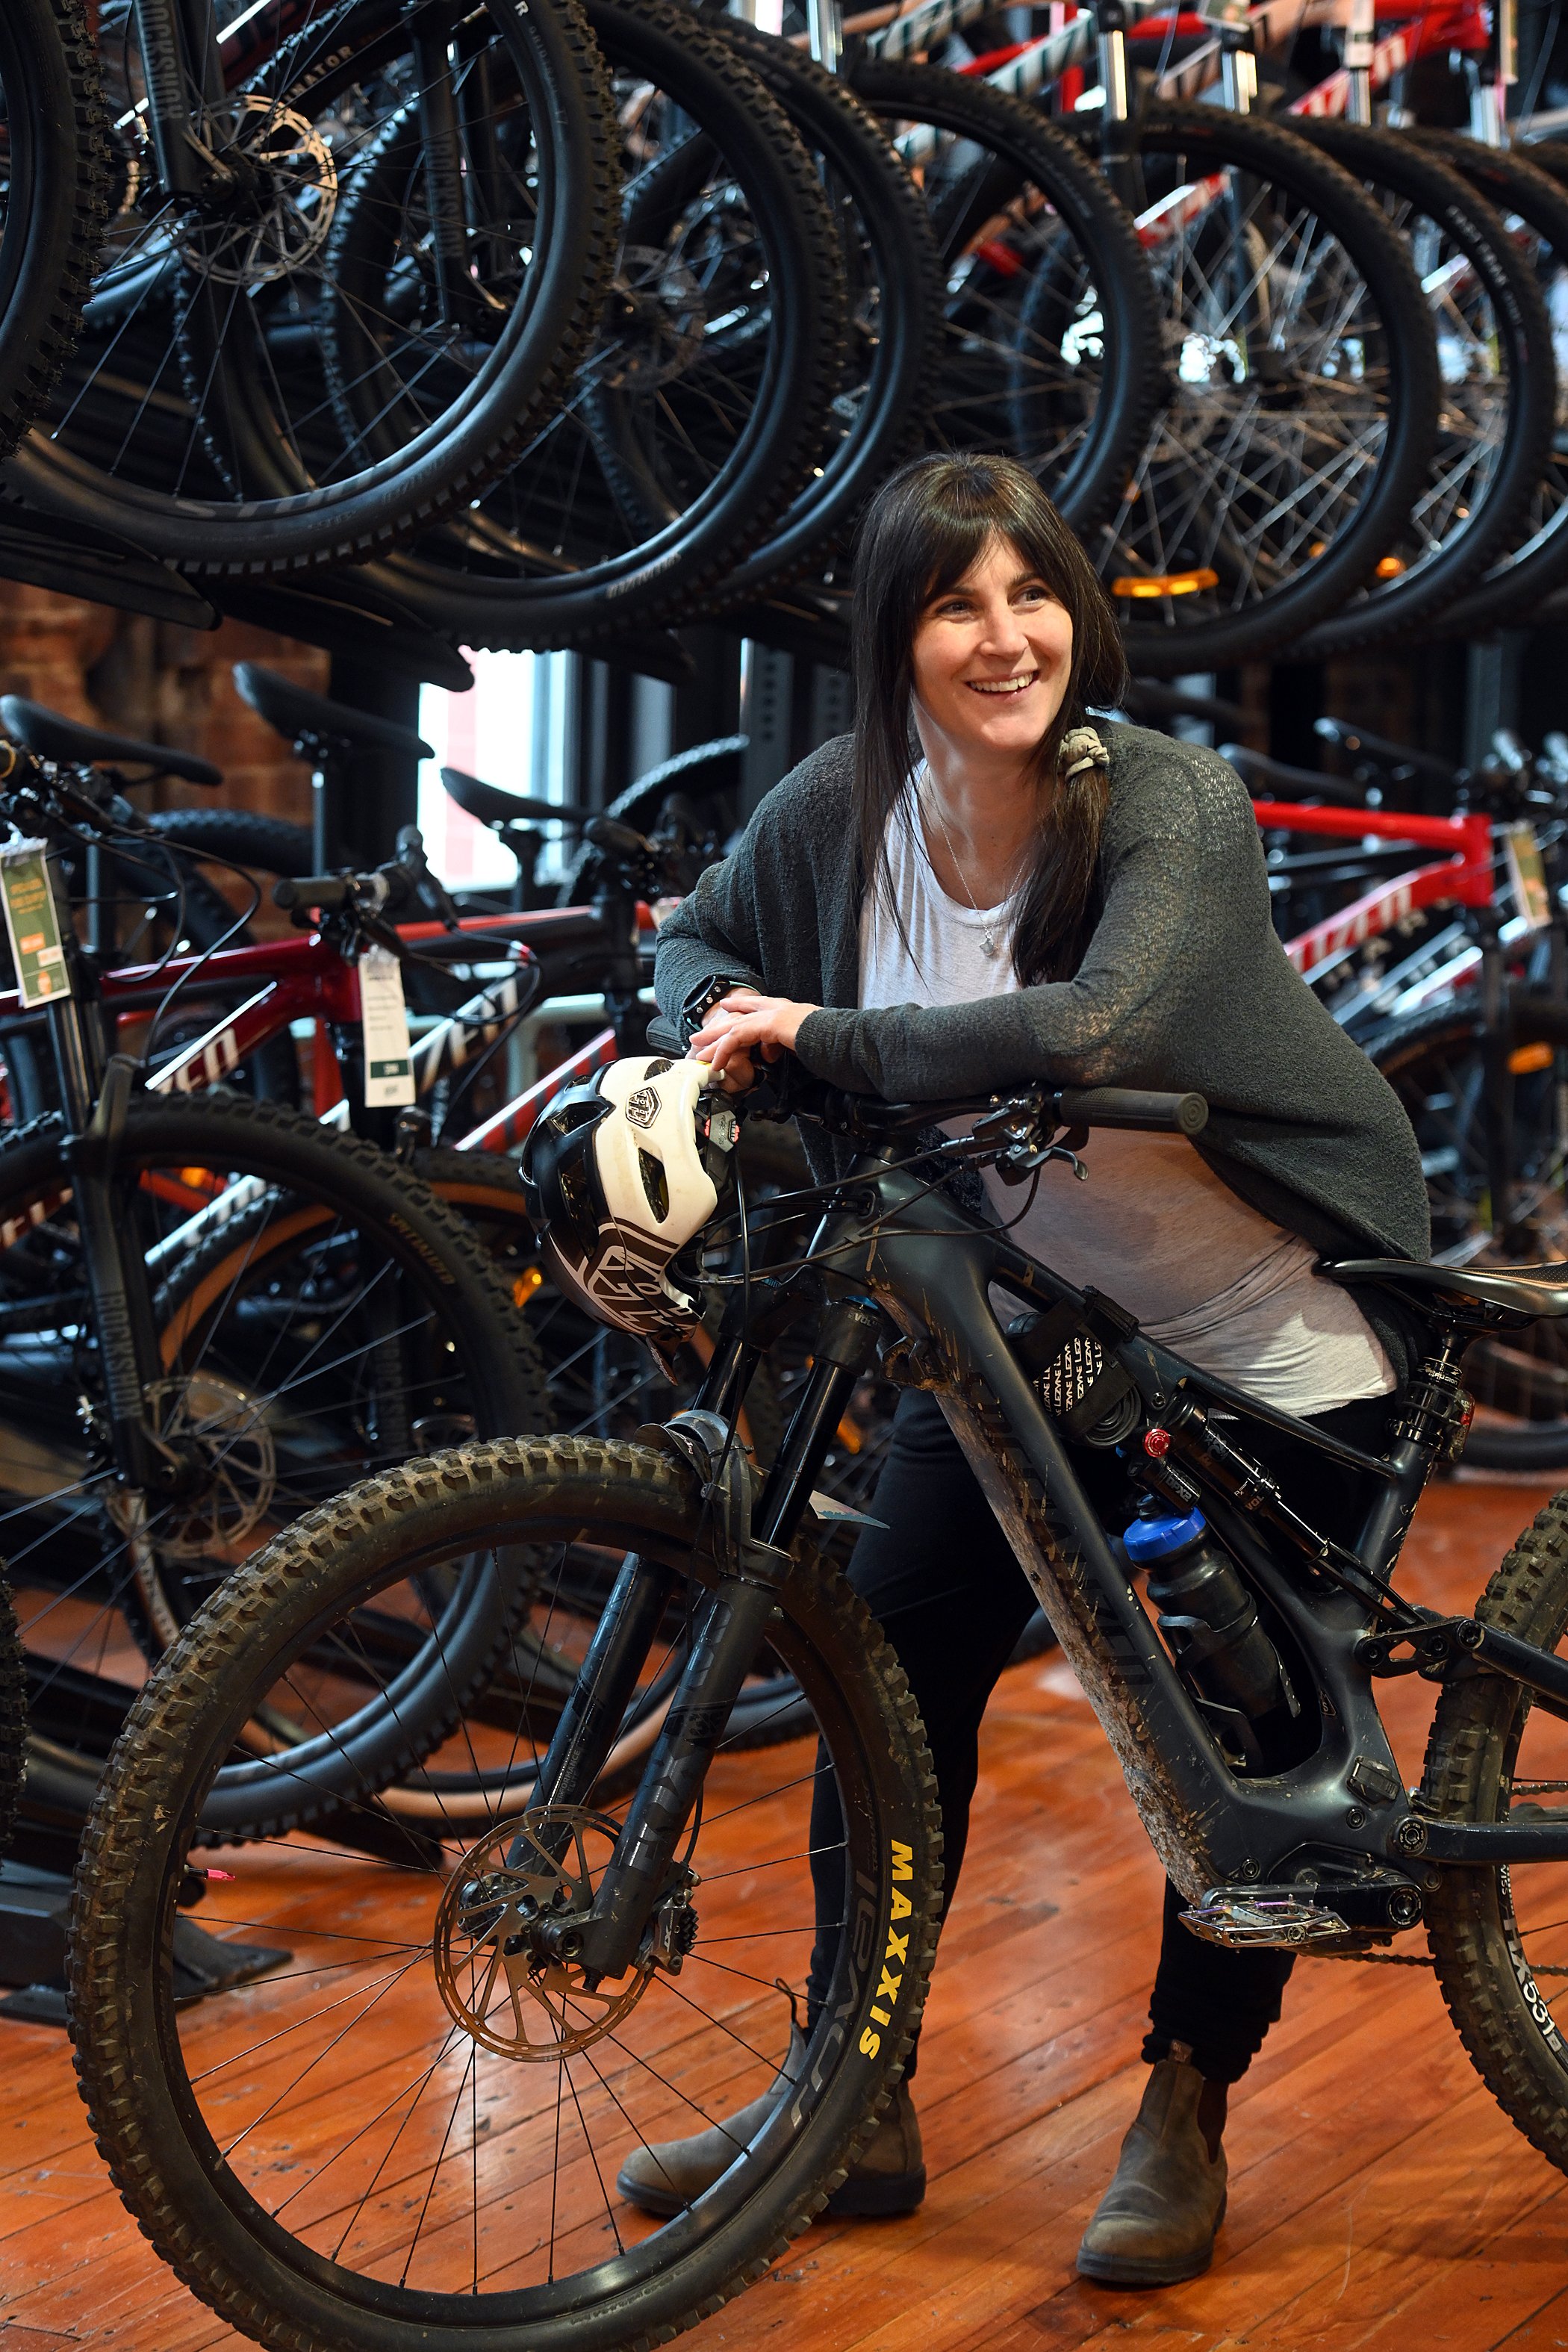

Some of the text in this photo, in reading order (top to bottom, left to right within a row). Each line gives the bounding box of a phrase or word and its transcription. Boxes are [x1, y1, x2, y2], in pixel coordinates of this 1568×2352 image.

[283, 43, 355, 106] INATOR
[1164, 1473, 1193, 1503] DPX2
[1244, 1496, 1265, 1511] VOL
[1499, 1864, 1508, 1897] WISS
[859, 1838, 914, 2061] MAXXIS
